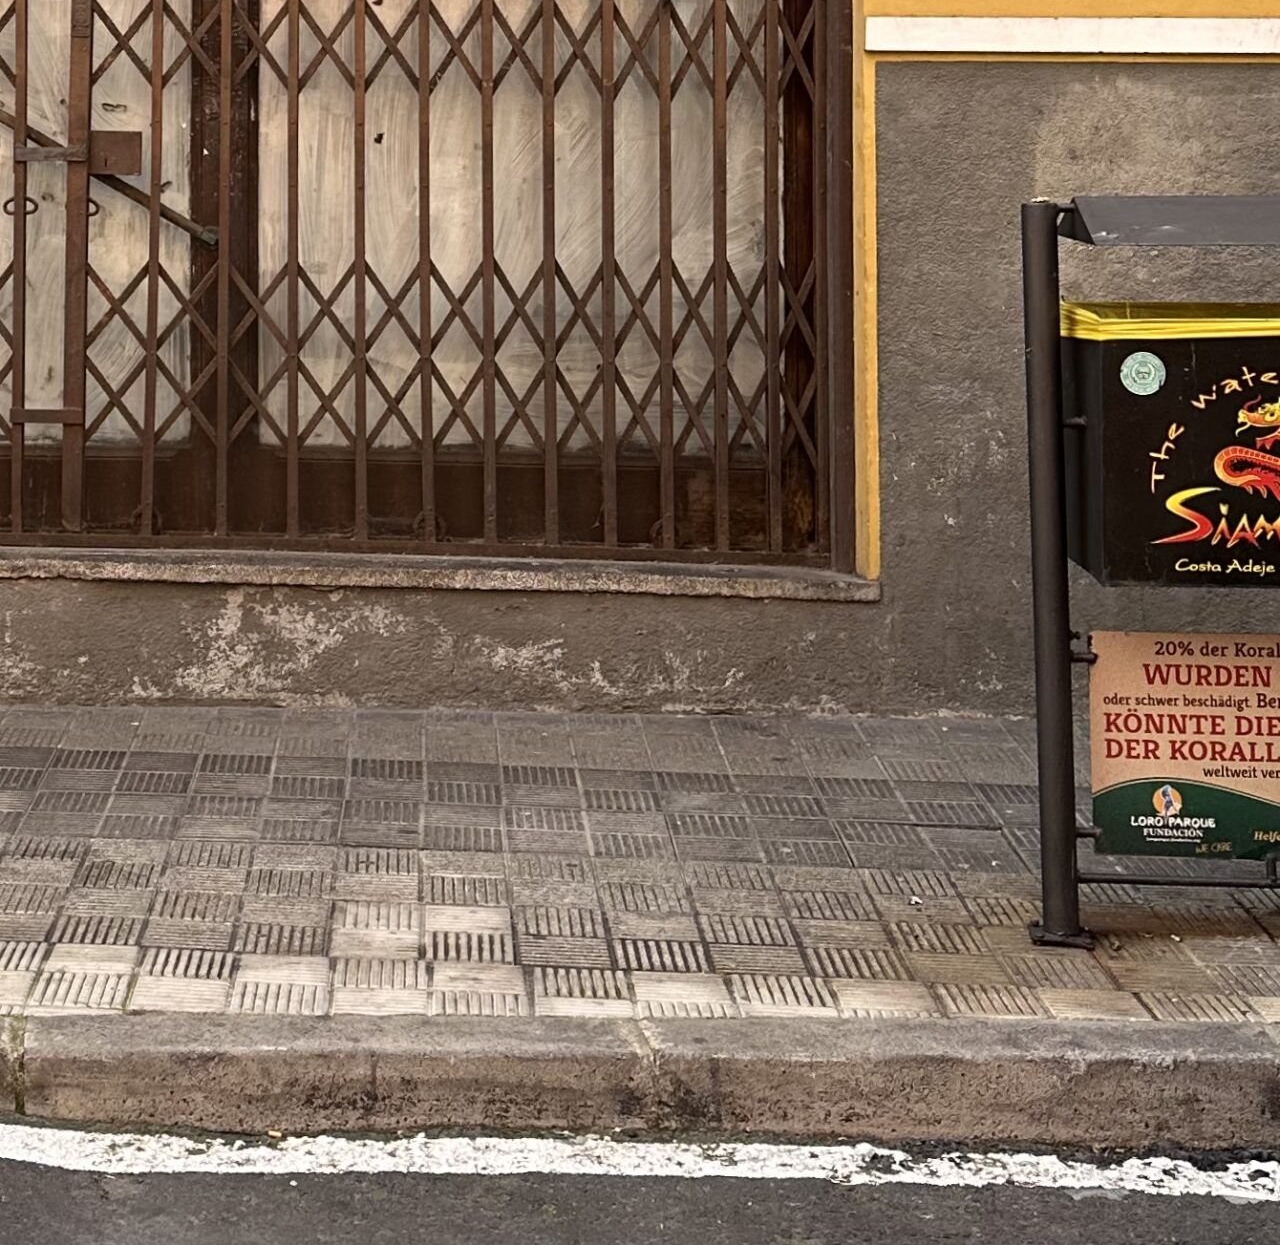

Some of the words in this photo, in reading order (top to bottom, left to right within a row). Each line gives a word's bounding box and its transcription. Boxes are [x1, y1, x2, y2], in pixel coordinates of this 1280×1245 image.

[1149, 422, 1185, 494] The
[1175, 558, 1221, 572] Costa
[1225, 559, 1276, 577] Adeje
[1154, 641, 1194, 656] 20%
[1200, 642, 1228, 656] der
[1234, 642, 1280, 658] Koral
[1142, 663, 1272, 687] WURDEN
[1103, 693, 1131, 706] oder
[1135, 693, 1180, 707] schwer
[1103, 708, 1226, 736] KÖNNTE
[1234, 715, 1280, 737] DIE
[1104, 738, 1161, 760] DER
[1168, 740, 1280, 763] KORALL
[1203, 765, 1258, 778] weltweit
[1130, 815, 1164, 827] LORO
[1168, 816, 1216, 828] PARQUE
[1143, 828, 1204, 837] FUNDACIÓN
